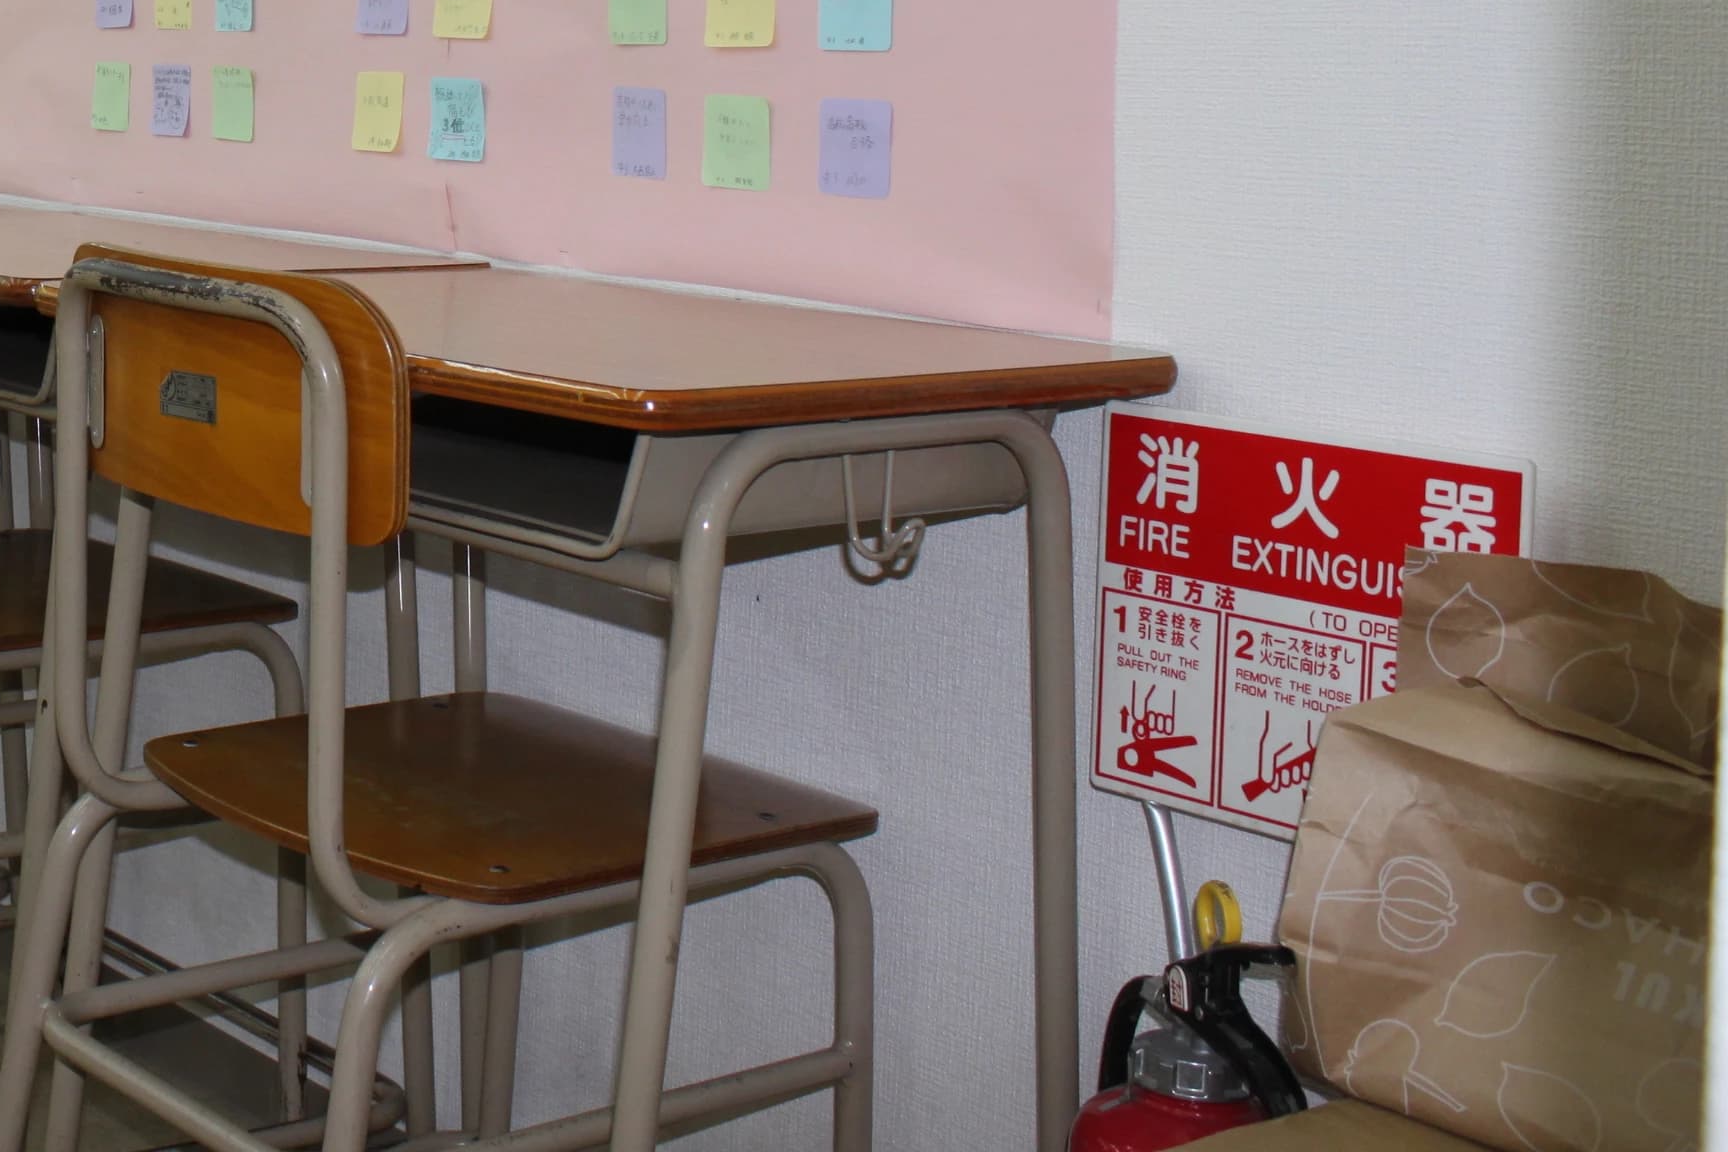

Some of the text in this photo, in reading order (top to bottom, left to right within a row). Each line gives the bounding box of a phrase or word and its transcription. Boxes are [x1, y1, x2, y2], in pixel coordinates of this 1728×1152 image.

[1119, 515, 1190, 559] FIRE
[1123, 568, 1236, 612] 使用方法
[1113, 605, 1127, 633] 1
[1138, 606, 1201, 633] 安全栓を
[1138, 622, 1199, 651] 引き抜く
[1234, 629, 1255, 661] 2
[1260, 631, 1356, 665] ホースをはずし
[1116, 655, 1187, 681] SAFETY RING
[1117, 642, 1200, 671] PULL OUT THE
[1259, 649, 1341, 681] 火元に向ける
[1234, 681, 1268, 699] FROM
[1274, 690, 1297, 706] THE
[1235, 668, 1353, 705] REMOVE THE HOSE
